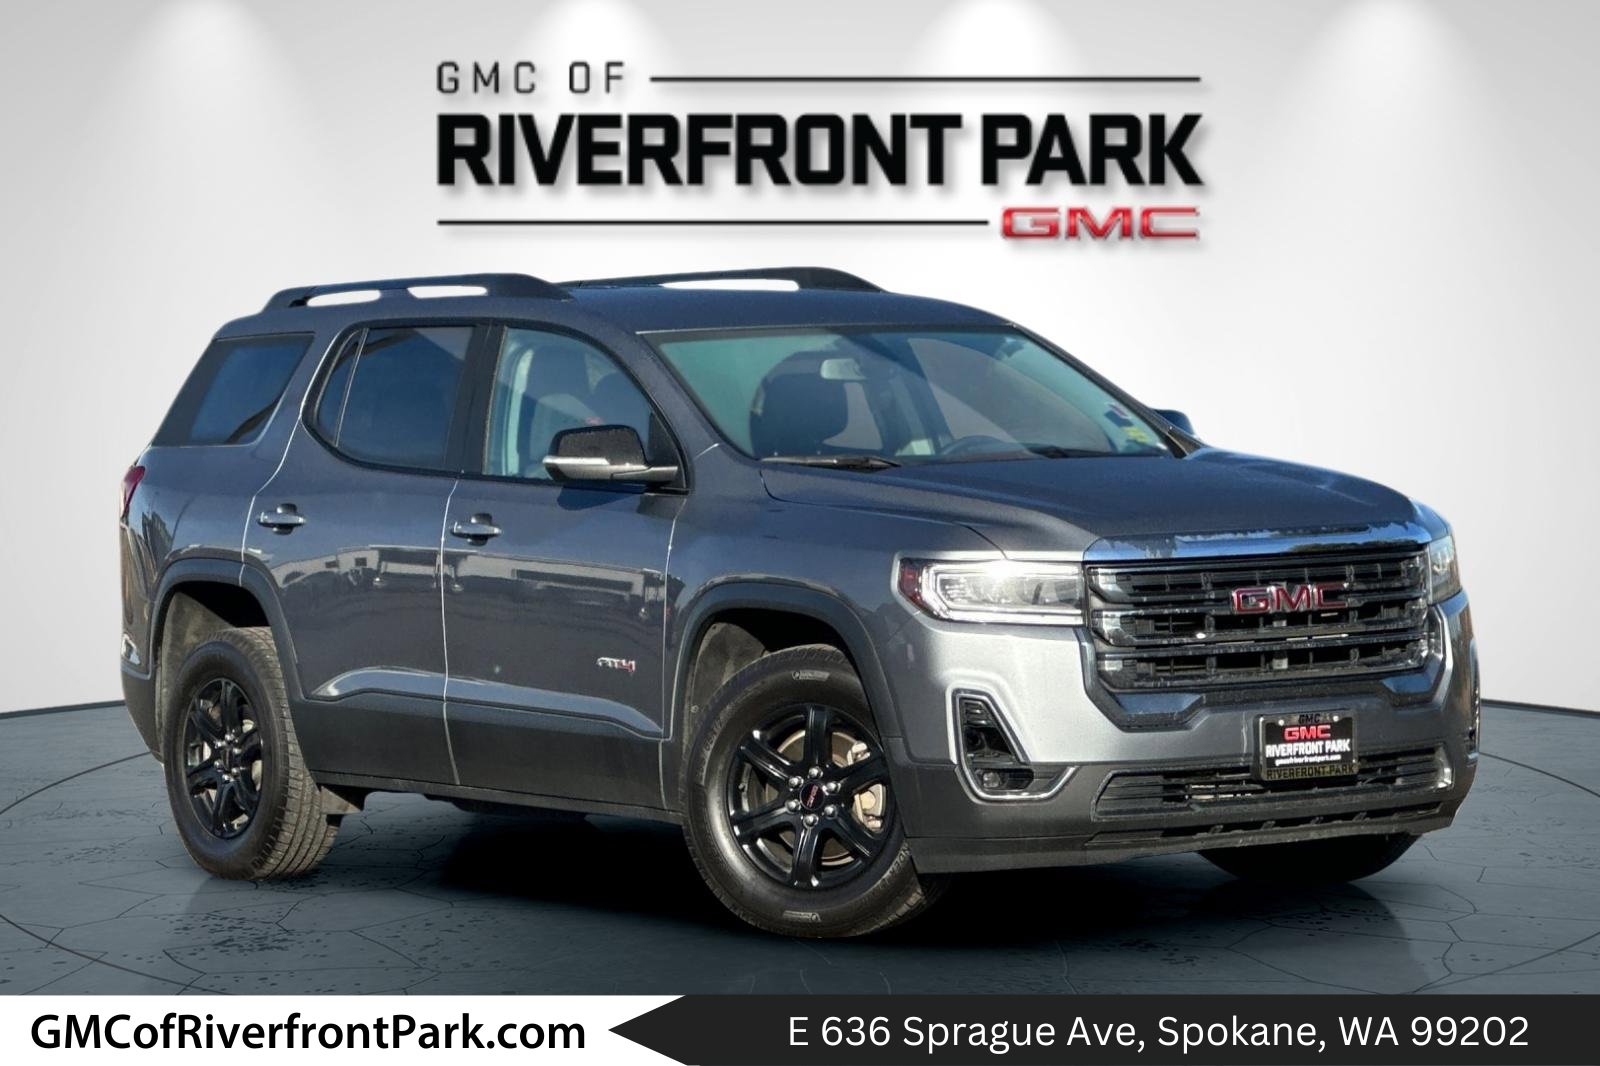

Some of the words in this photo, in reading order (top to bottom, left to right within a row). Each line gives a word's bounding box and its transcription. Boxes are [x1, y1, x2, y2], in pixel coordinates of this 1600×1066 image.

[1231, 582, 1349, 614] GMC
[597, 657, 636, 673] AT4
[1298, 713, 1321, 725] GMC
[1283, 725, 1331, 741] GMC
[1266, 742, 1323, 758] RIVERFRONT
[1325, 739, 1351, 753] PARK
[1266, 766, 1328, 780] RIVERFRONT
[1329, 762, 1354, 776] PARK
